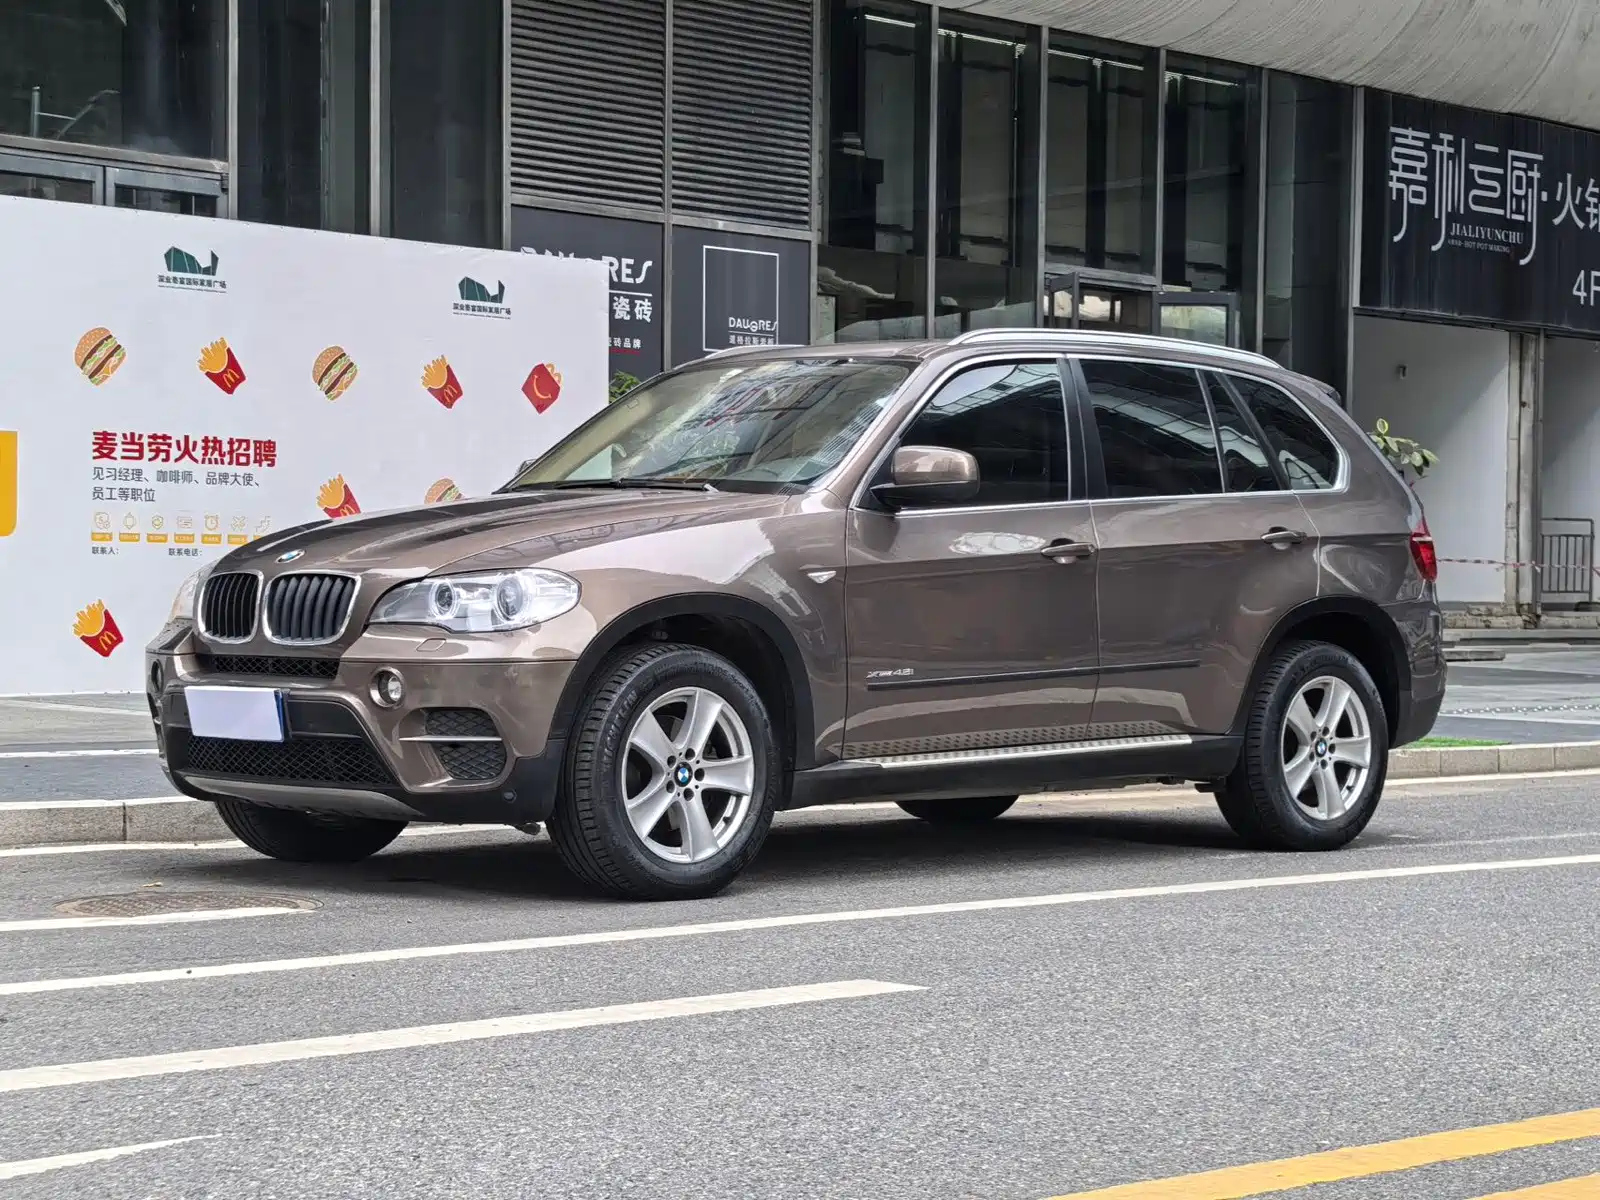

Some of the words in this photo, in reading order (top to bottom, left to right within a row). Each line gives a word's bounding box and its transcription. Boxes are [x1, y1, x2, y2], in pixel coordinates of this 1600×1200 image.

[1450, 222, 1525, 245] JIALIYUNCHU
[92, 430, 277, 468] 麦当劳火热招聘
[92, 487, 156, 503] 员工等职位
